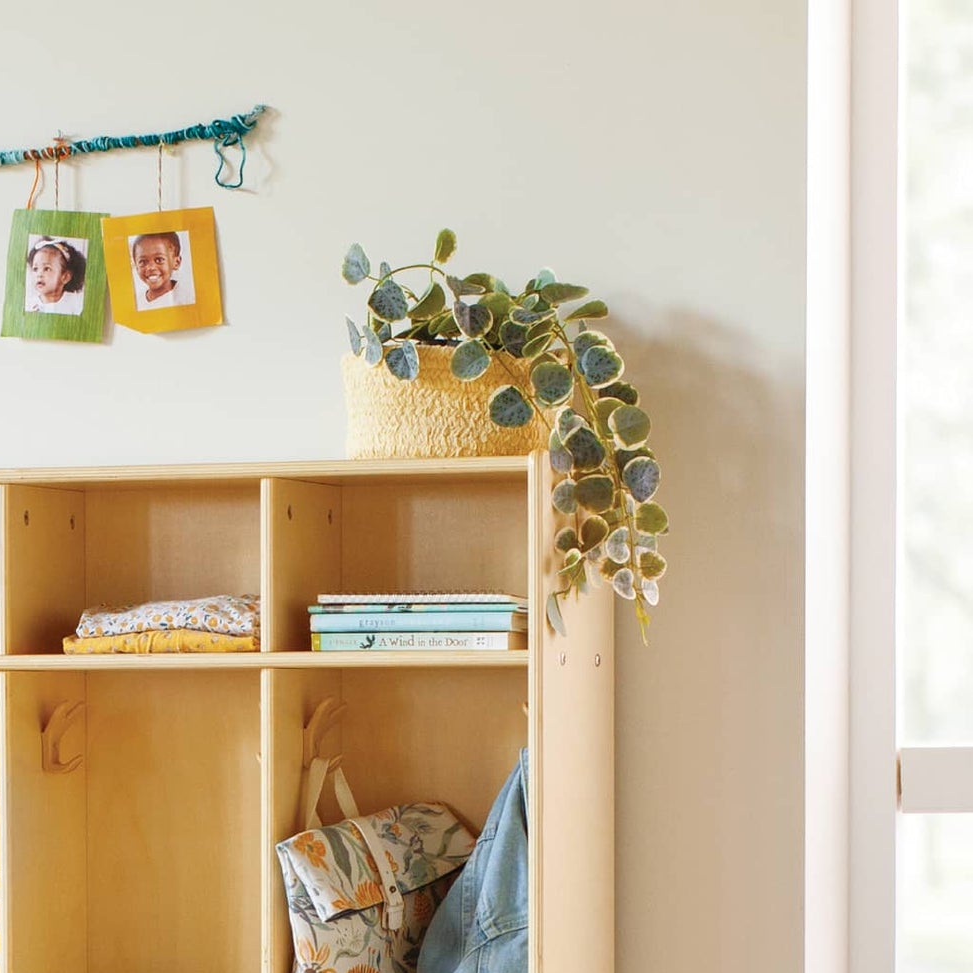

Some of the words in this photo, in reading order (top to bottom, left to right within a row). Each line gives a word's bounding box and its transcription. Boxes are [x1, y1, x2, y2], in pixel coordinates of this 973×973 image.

[359, 619, 396, 628] grayson
[379, 638, 387, 647] A
[389, 634, 415, 647] Wind
[417, 636, 426, 647] in
[429, 637, 442, 647] the
[444, 637, 468, 647] Door
